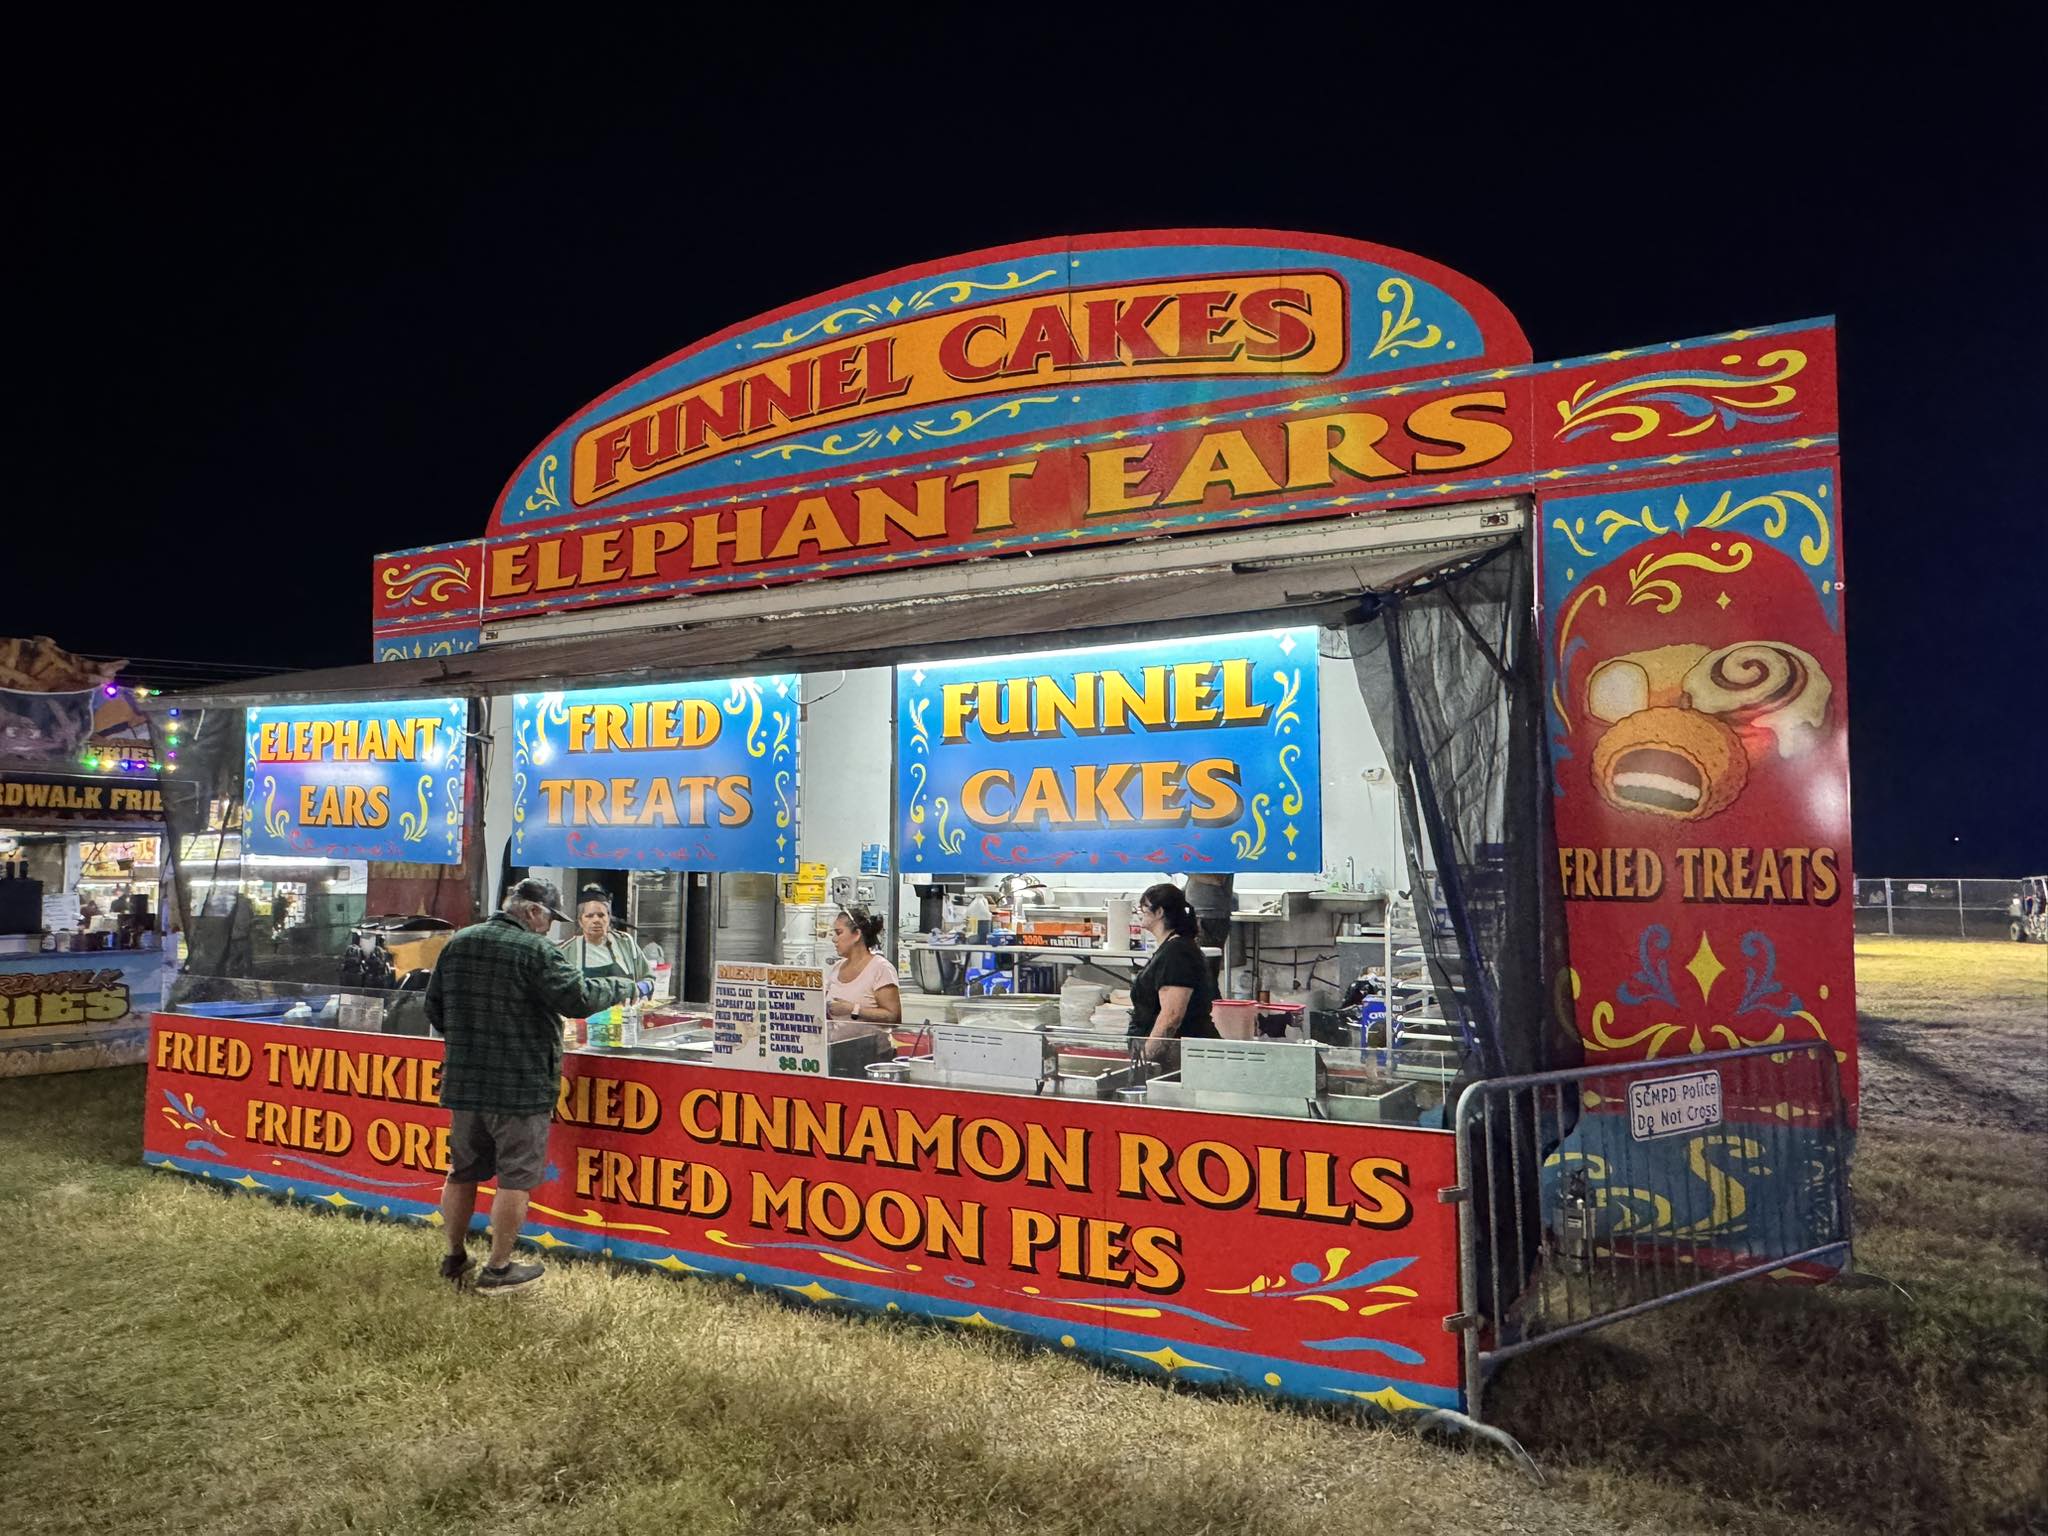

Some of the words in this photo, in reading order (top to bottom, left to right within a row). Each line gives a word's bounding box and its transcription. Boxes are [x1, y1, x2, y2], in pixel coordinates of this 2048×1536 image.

[591, 337, 912, 490] FUNNEL
[938, 287, 1314, 381] CAKES
[488, 461, 1038, 598] ELEPHANT
[1084, 391, 1513, 521] EARS
[940, 658, 1277, 745] FUNNEL
[259, 717, 443, 763] ELEPHANT
[567, 699, 722, 754] FRIED
[299, 785, 390, 829] EARS
[539, 775, 754, 828] TREATS
[961, 757, 1246, 832] CAKES
[1558, 847, 1663, 901] FRIED
[1675, 847, 1840, 905] TREATS
[717, 964, 767, 982] MENU
[768, 990, 783, 1000] KEY
[785, 991, 806, 1001] LIME
[768, 1001, 796, 1011] LEMON
[769, 1012, 816, 1024] BLUEBERRY
[769, 1023, 823, 1035] STRAWBERRY
[770, 1033, 801, 1044] CHERRY
[779, 1055, 820, 1073] $8.00
[1635, 1086, 1677, 1109] SCMPD
[1683, 1079, 1717, 1099] Police
[155, 1030, 253, 1081] FRIED
[554, 1075, 663, 1134] RIED
[679, 1088, 1092, 1193] CINNAMON
[1117, 1130, 1414, 1231] ROLLS
[1638, 1114, 1655, 1131] Do
[1661, 1108, 1682, 1127] Not
[1687, 1103, 1718, 1121] Cross
[245, 1099, 353, 1156] FRIED
[576, 1146, 731, 1219] FRIED
[749, 1171, 986, 1265] MOON
[1009, 1206, 1186, 1295] PIES
